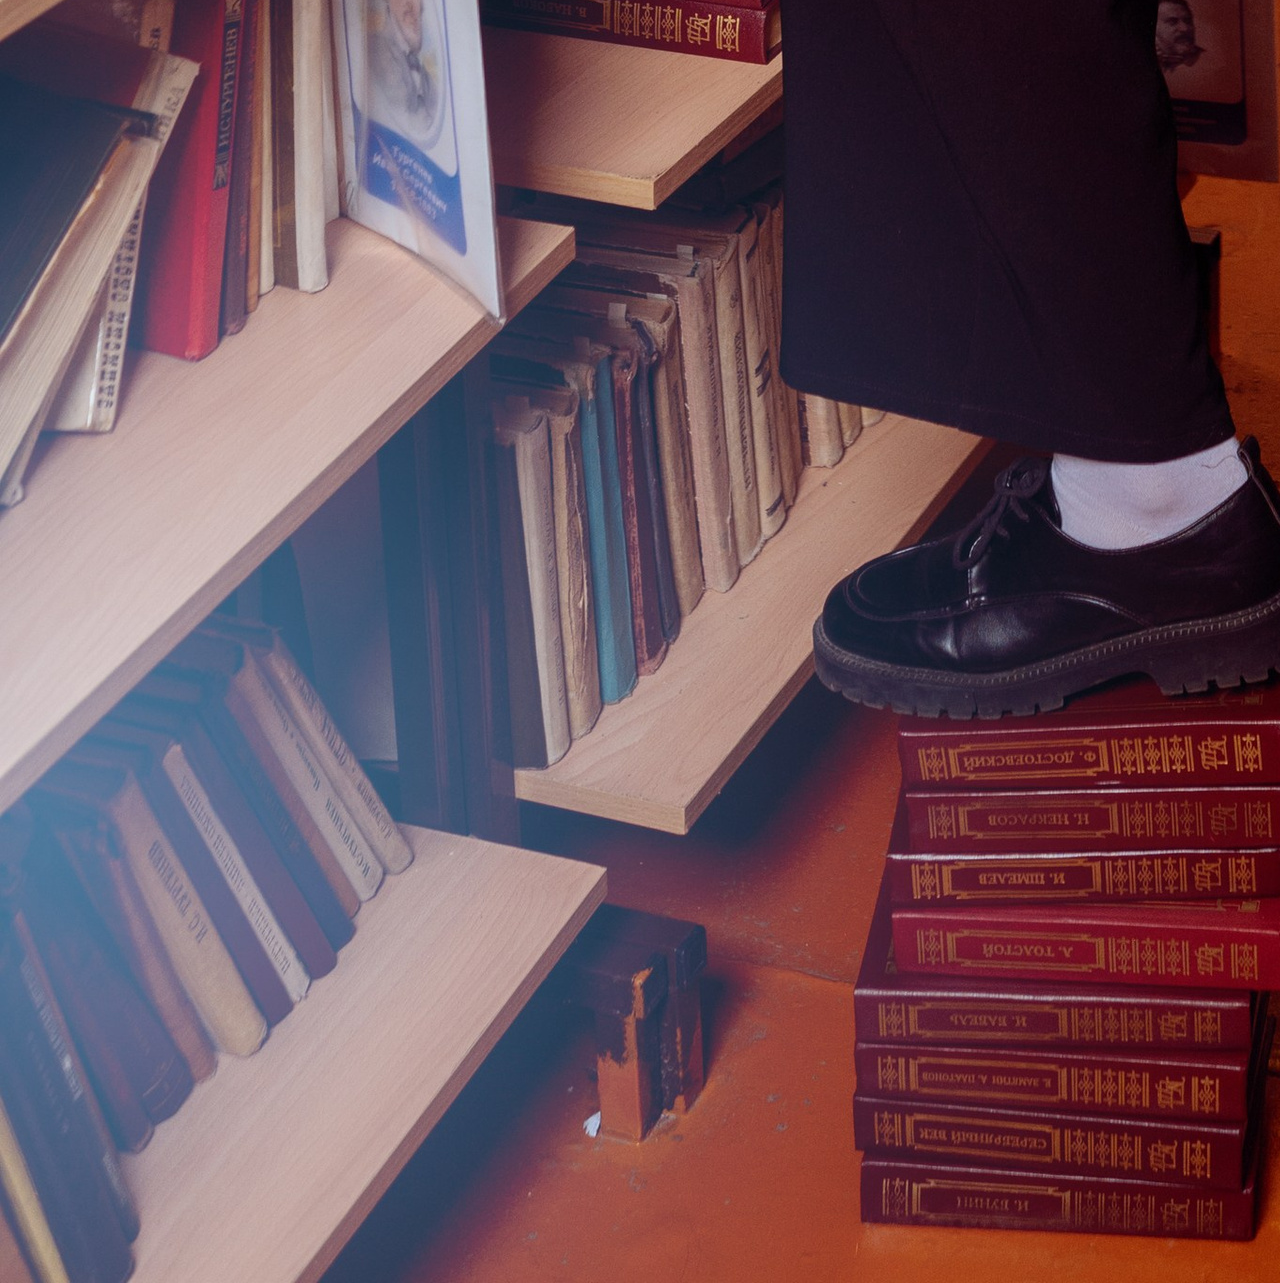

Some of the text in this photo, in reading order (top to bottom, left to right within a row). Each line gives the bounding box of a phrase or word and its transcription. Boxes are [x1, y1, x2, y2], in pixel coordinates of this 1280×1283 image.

[963, 750, 1096, 771] Ф. ДОСТОЕВСКИЙ
[988, 813, 1089, 826] Н. НЕКРАСОВ
[147, 838, 192, 914] ТУРГЕНЕВ
[978, 872, 1066, 885] И. ШМЕЛЕВ
[982, 944, 1055, 958] ТОЛСТОЙ
[949, 1013, 1027, 1027] И. БАБЕЛЬ
[922, 1071, 975, 1081] ПЛАТОНОВ
[977, 1074, 988, 1084] А.
[919, 1127, 1046, 1148] СЕРЕБРЯНЫЙ ВЕК
